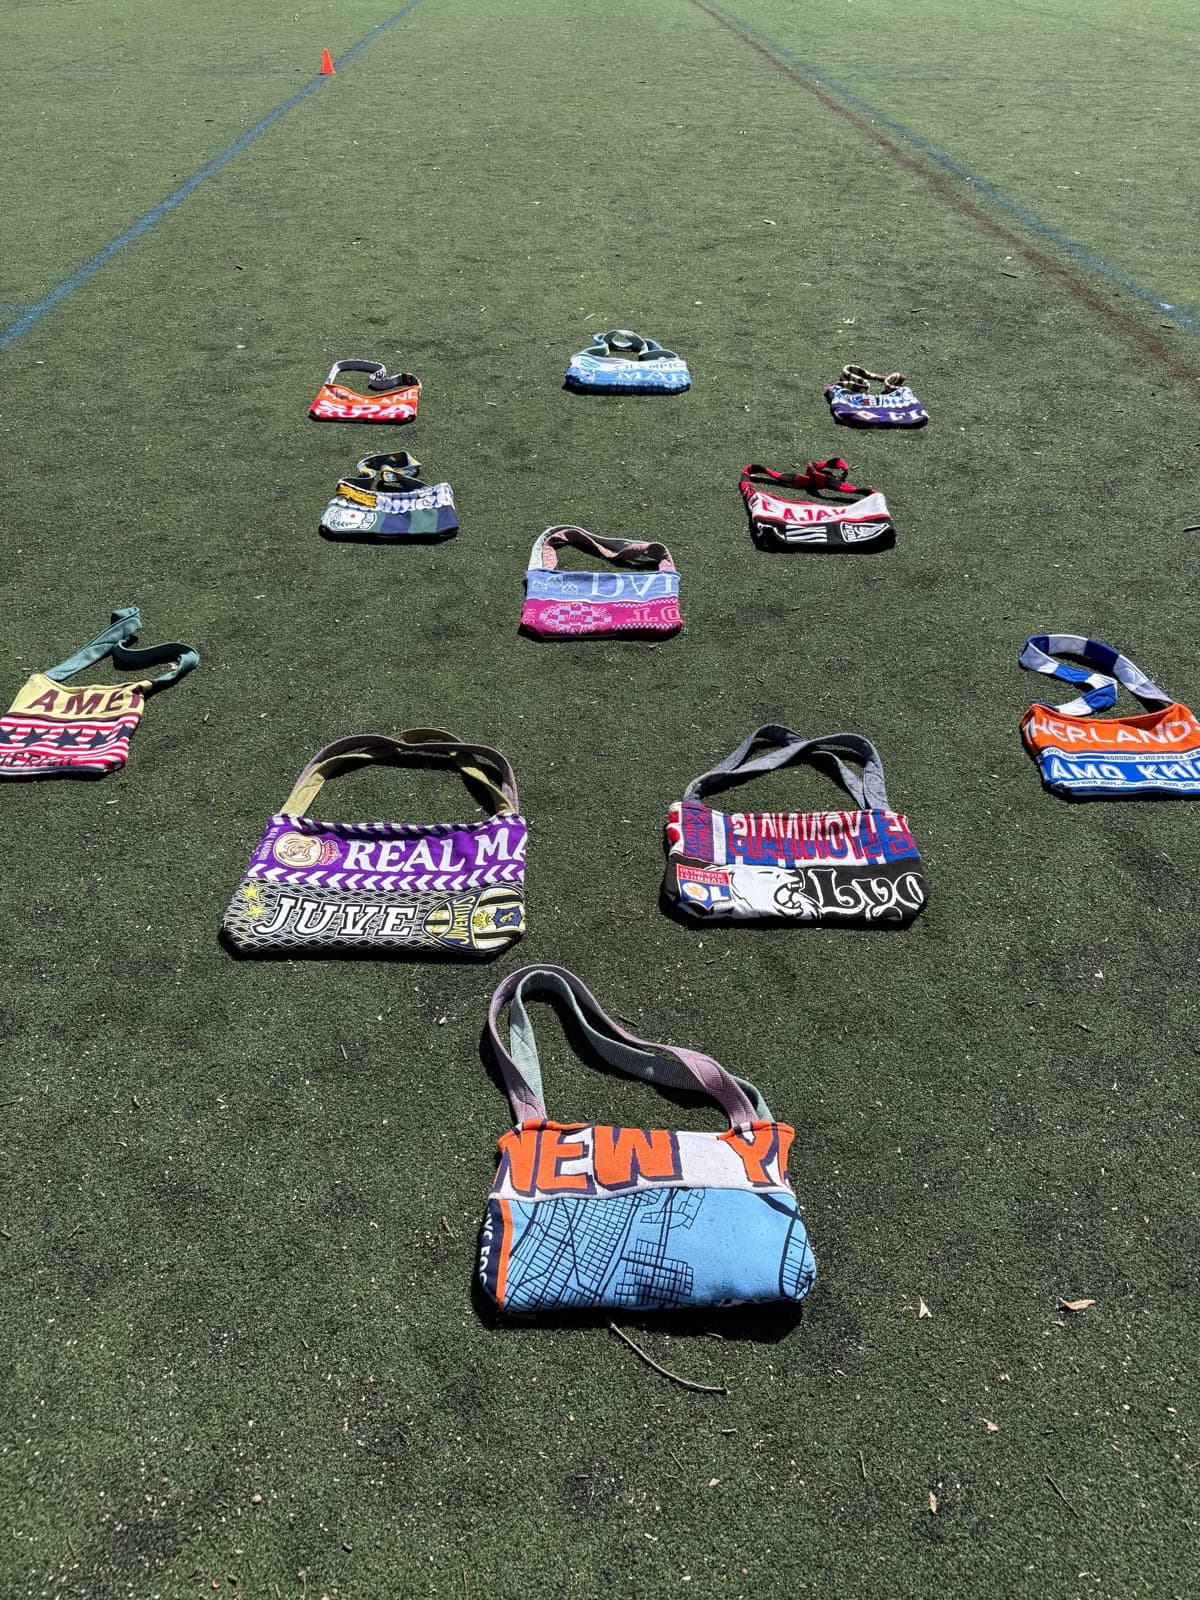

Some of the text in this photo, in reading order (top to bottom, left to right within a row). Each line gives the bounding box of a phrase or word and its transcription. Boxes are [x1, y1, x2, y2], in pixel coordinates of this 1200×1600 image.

[343, 838, 467, 873] REAL
[251, 896, 418, 938] JUVE
[443, 895, 476, 945] JUVENTUS
[493, 1122, 684, 1197] NEW
